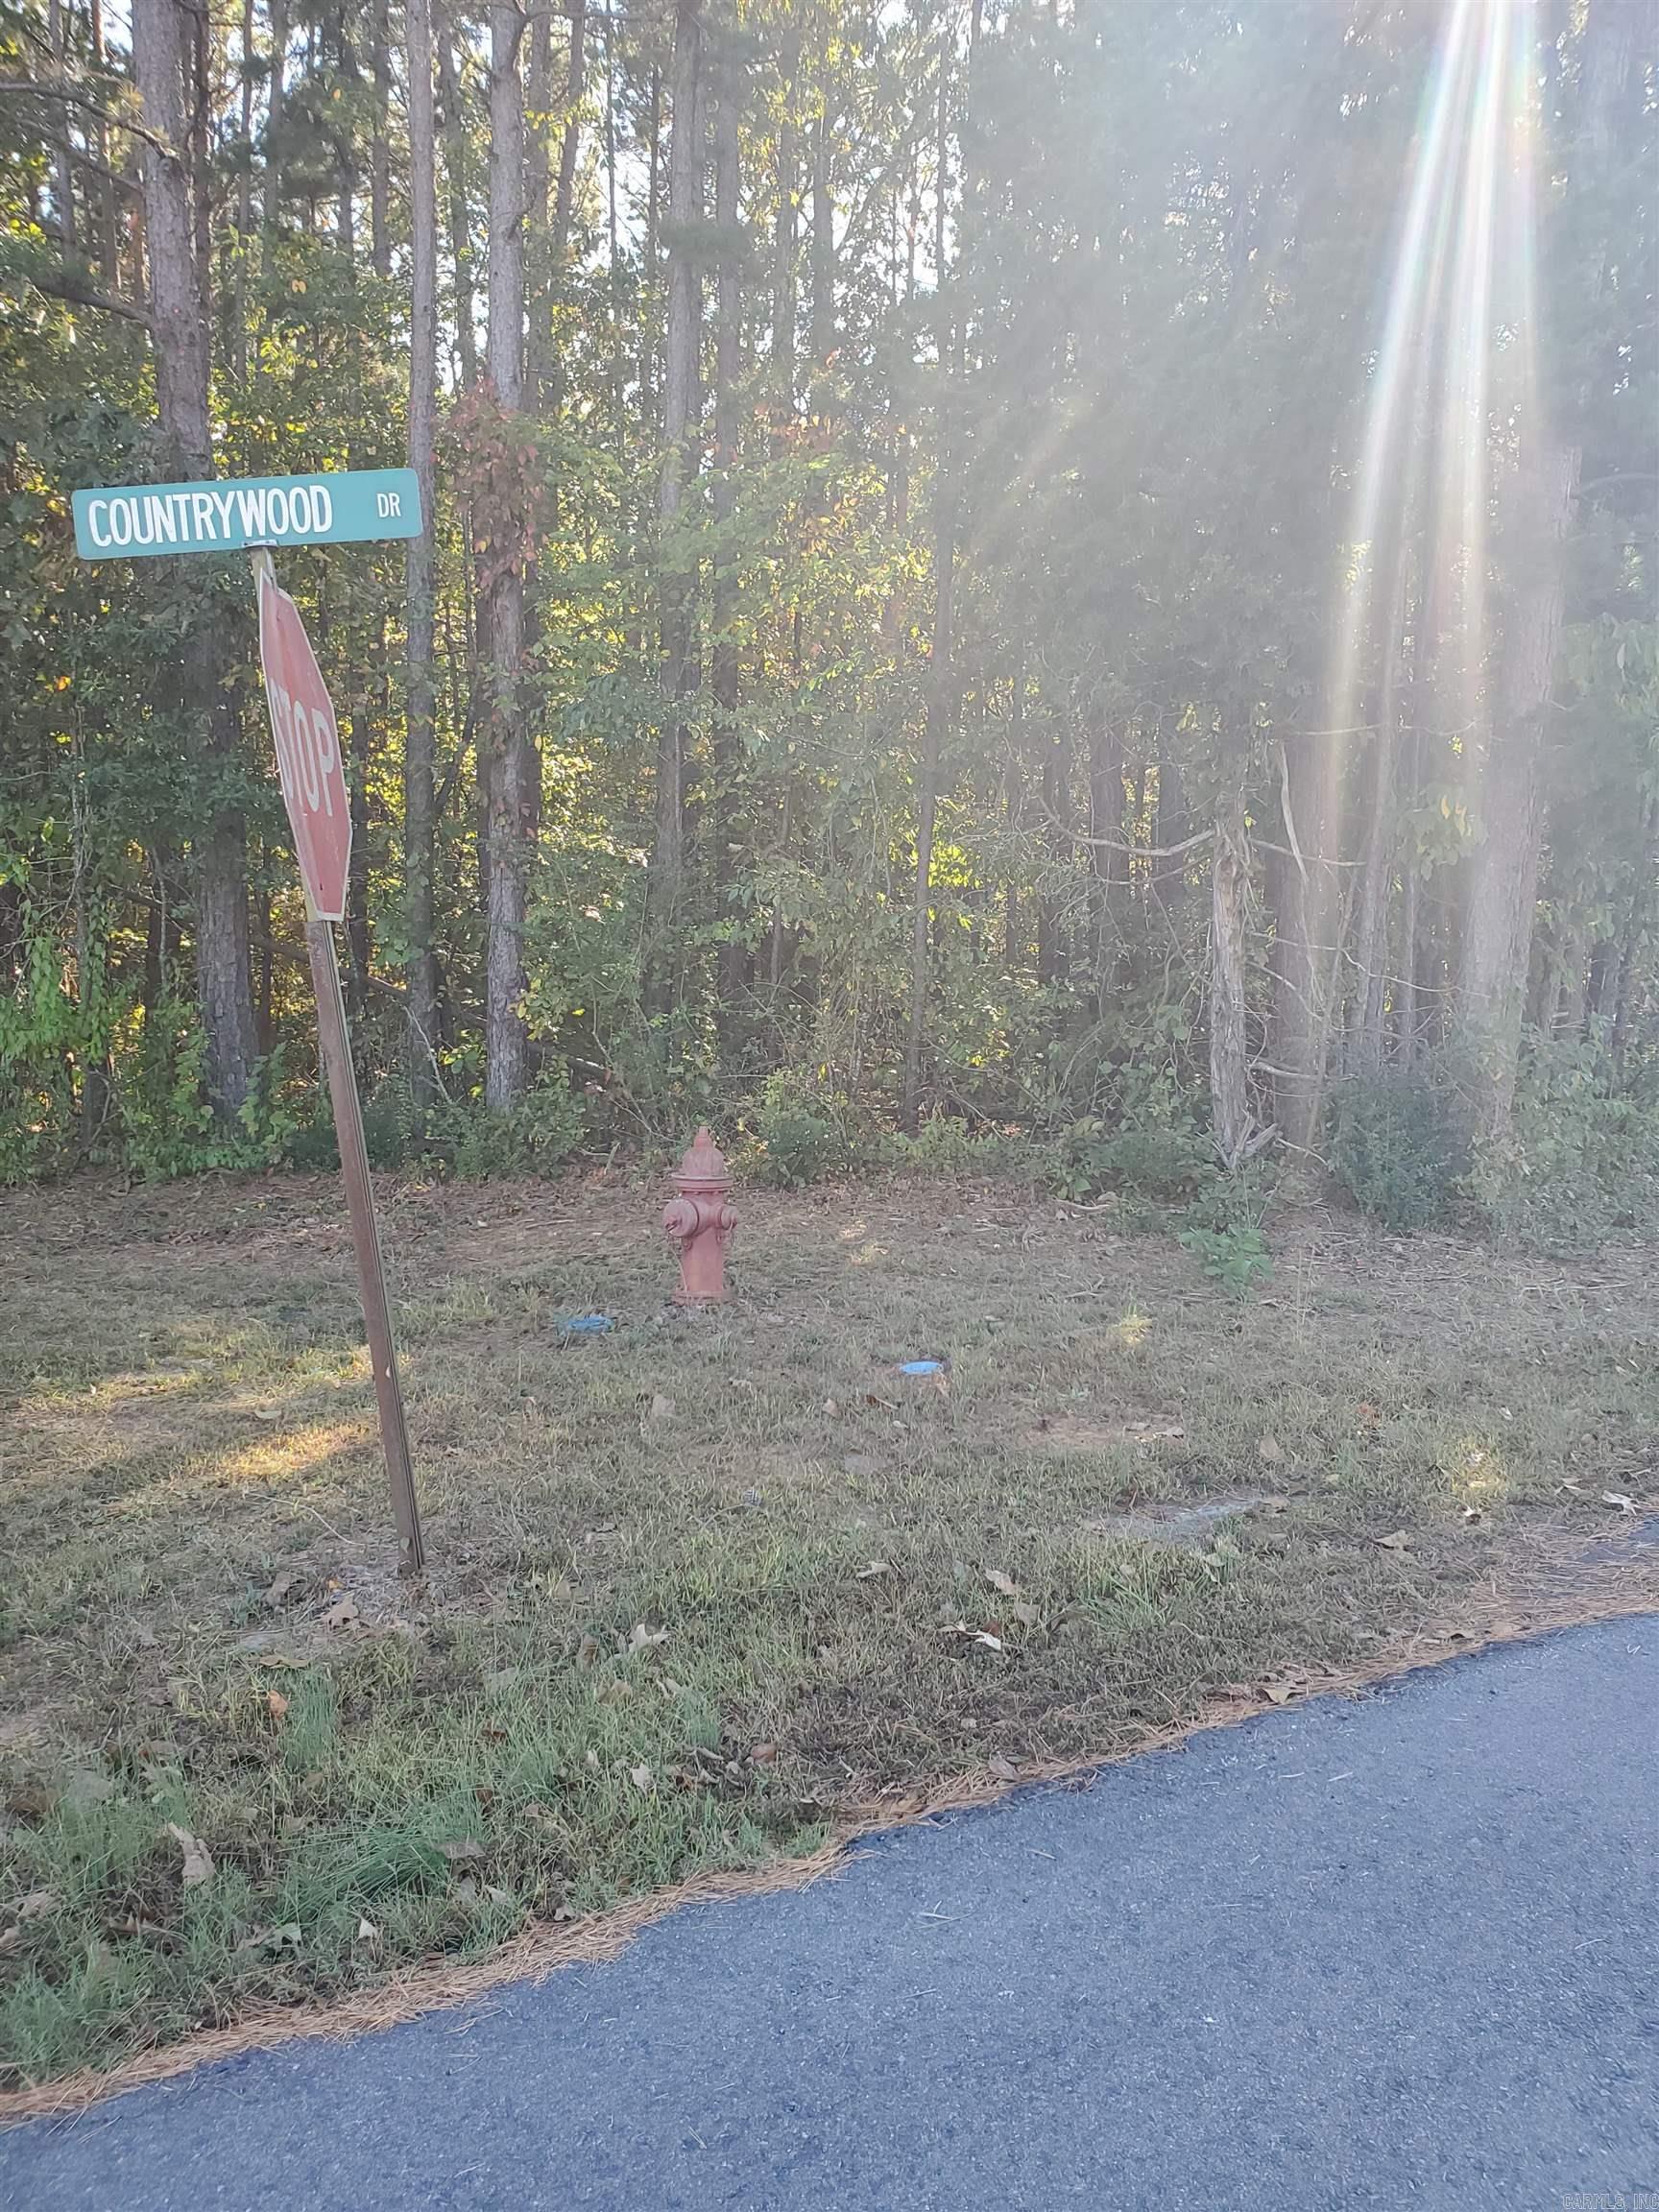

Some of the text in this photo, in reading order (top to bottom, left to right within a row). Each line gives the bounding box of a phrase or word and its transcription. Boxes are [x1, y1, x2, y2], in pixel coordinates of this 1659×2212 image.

[88, 485, 401, 547] COUNTRYWOOD DR
[270, 678, 335, 817] STOP
